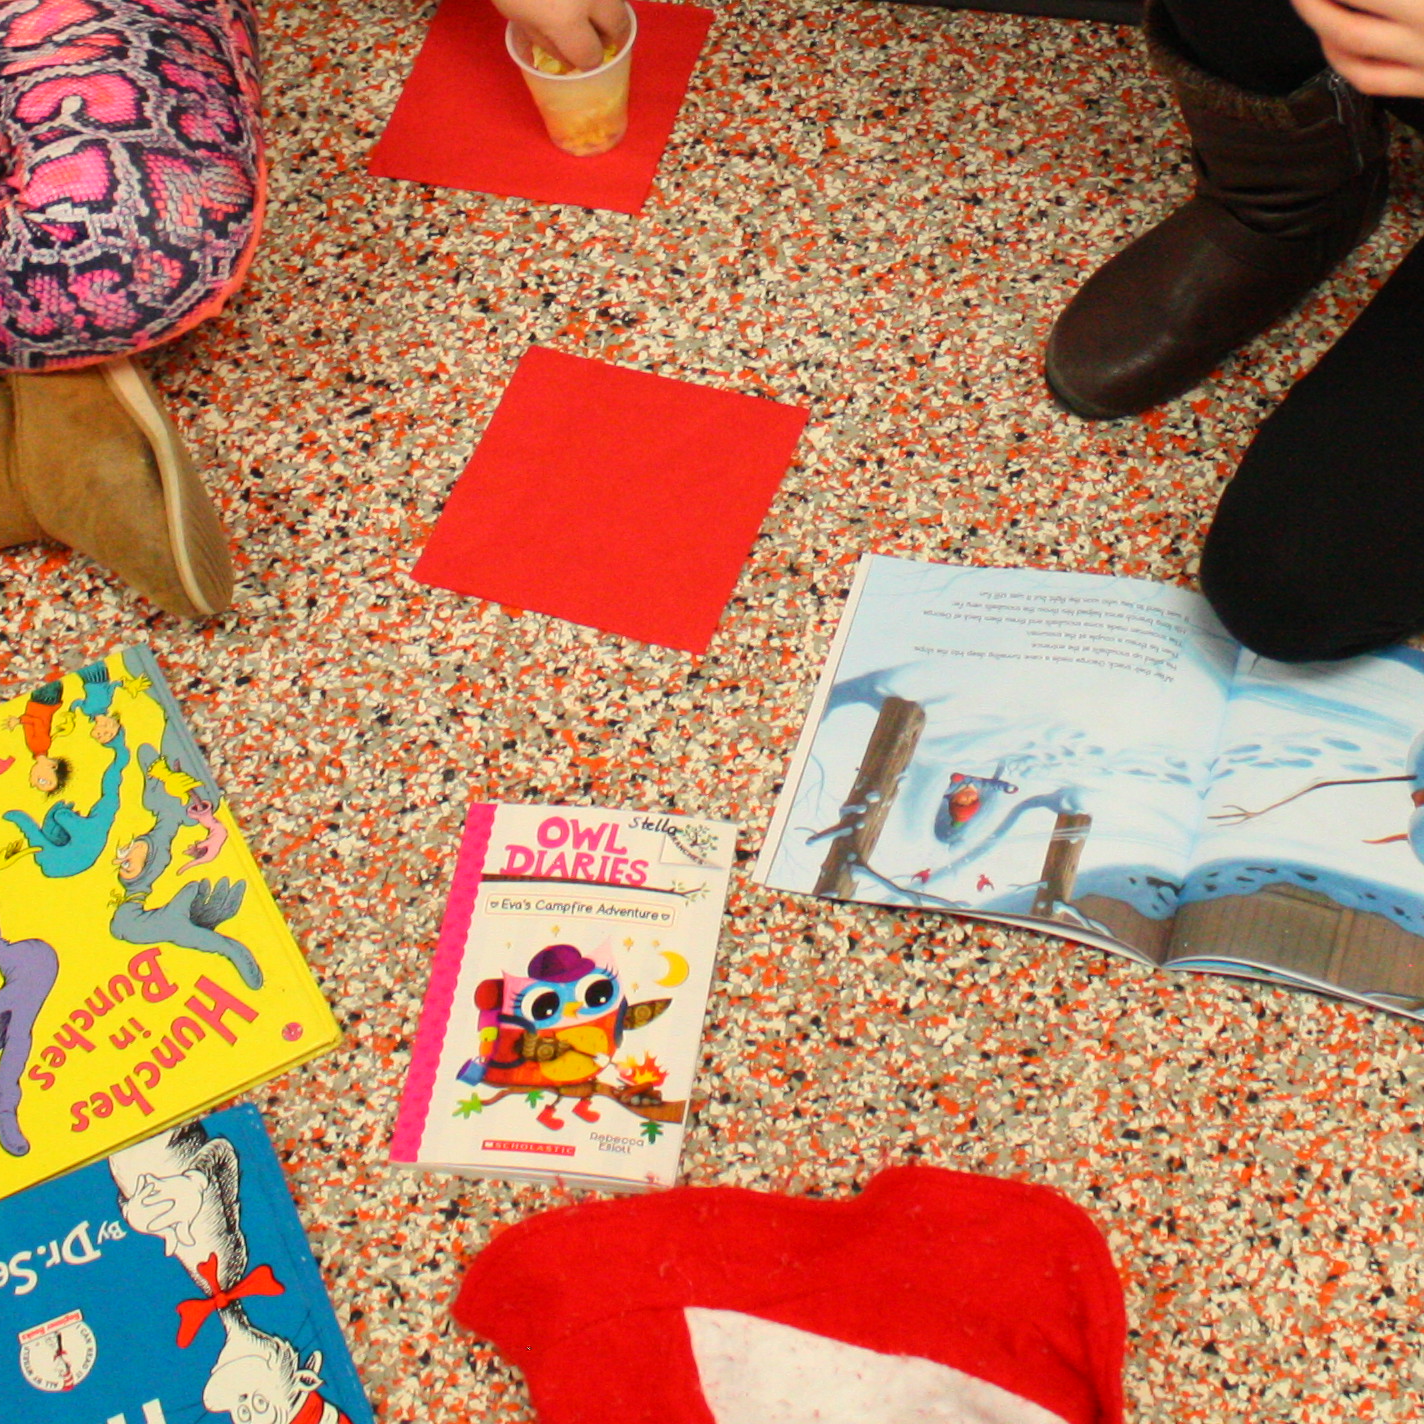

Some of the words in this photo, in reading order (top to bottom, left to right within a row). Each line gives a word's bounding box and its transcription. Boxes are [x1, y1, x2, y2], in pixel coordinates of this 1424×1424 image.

[537, 816, 628, 855] OWL
[628, 816, 681, 836] Stella
[500, 844, 649, 886] DIARIES
[501, 899, 531, 912] Eva's
[536, 900, 593, 915] Campfire
[596, 904, 659, 921] Adventure
[28, 947, 179, 1091] Bunches
[109, 1017, 152, 1049] in
[70, 975, 259, 1132] Hunches
[496, 1142, 574, 1154] SCHOLASTIC
[36, 1220, 102, 1268] Dr.
[97, 1220, 128, 1244] By
